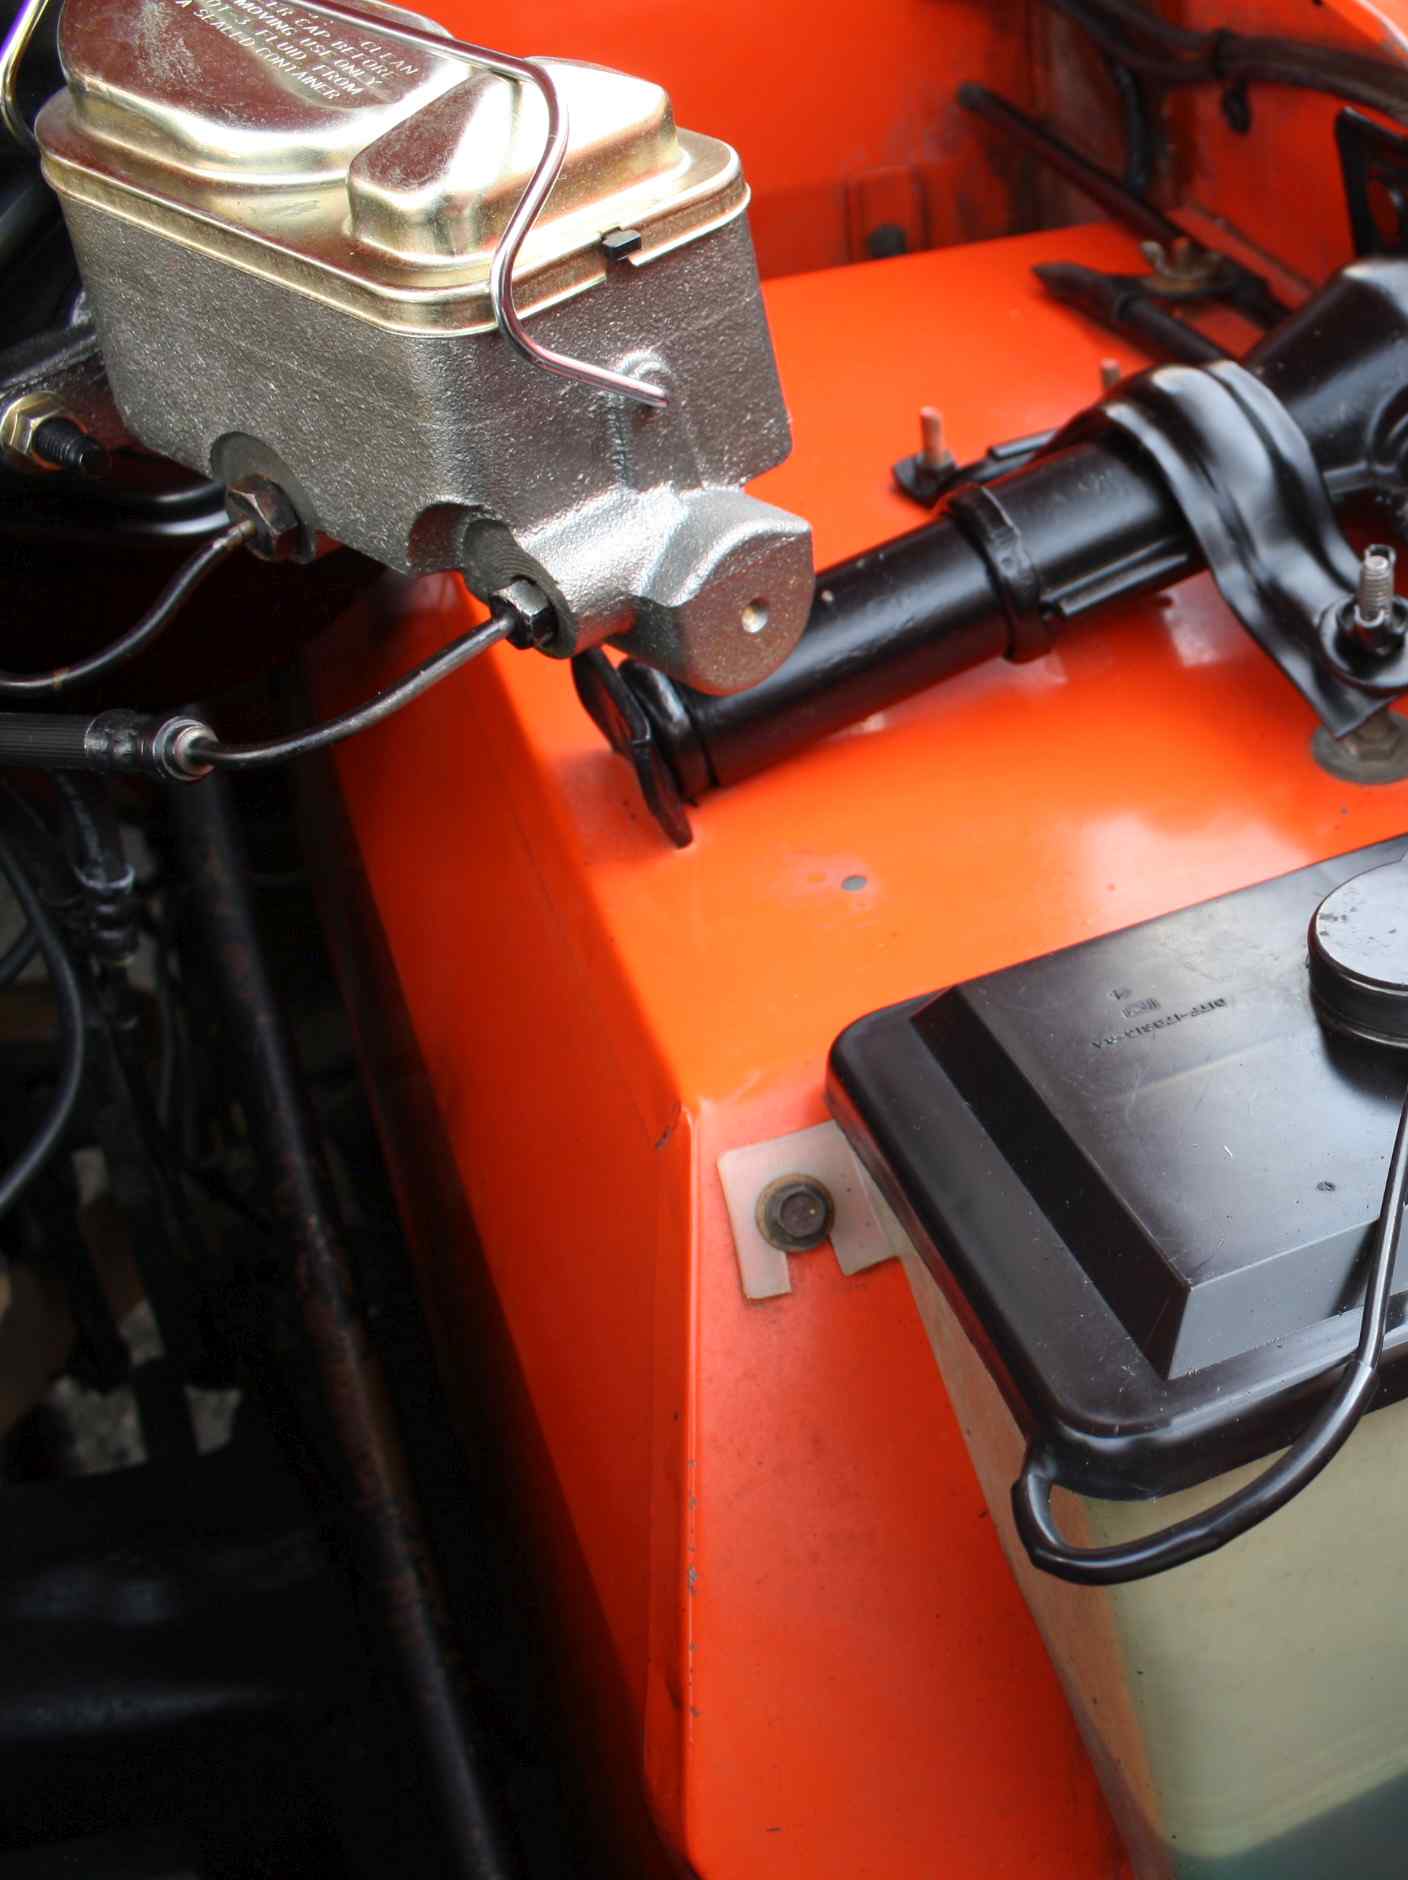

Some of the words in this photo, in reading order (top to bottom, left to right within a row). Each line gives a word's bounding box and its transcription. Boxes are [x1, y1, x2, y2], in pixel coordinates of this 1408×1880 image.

[193, 9, 255, 47] SEALED
[255, 47, 341, 99] CONTAINER
[255, 29, 307, 60] FLUID
[312, 64, 364, 95] FROM
[294, 18, 330, 38] CAP
[331, 41, 394, 77] BEFORE
[300, 38, 332, 57] USE
[334, 59, 383, 85] ONLY
[360, 41, 418, 74] CLEAN
